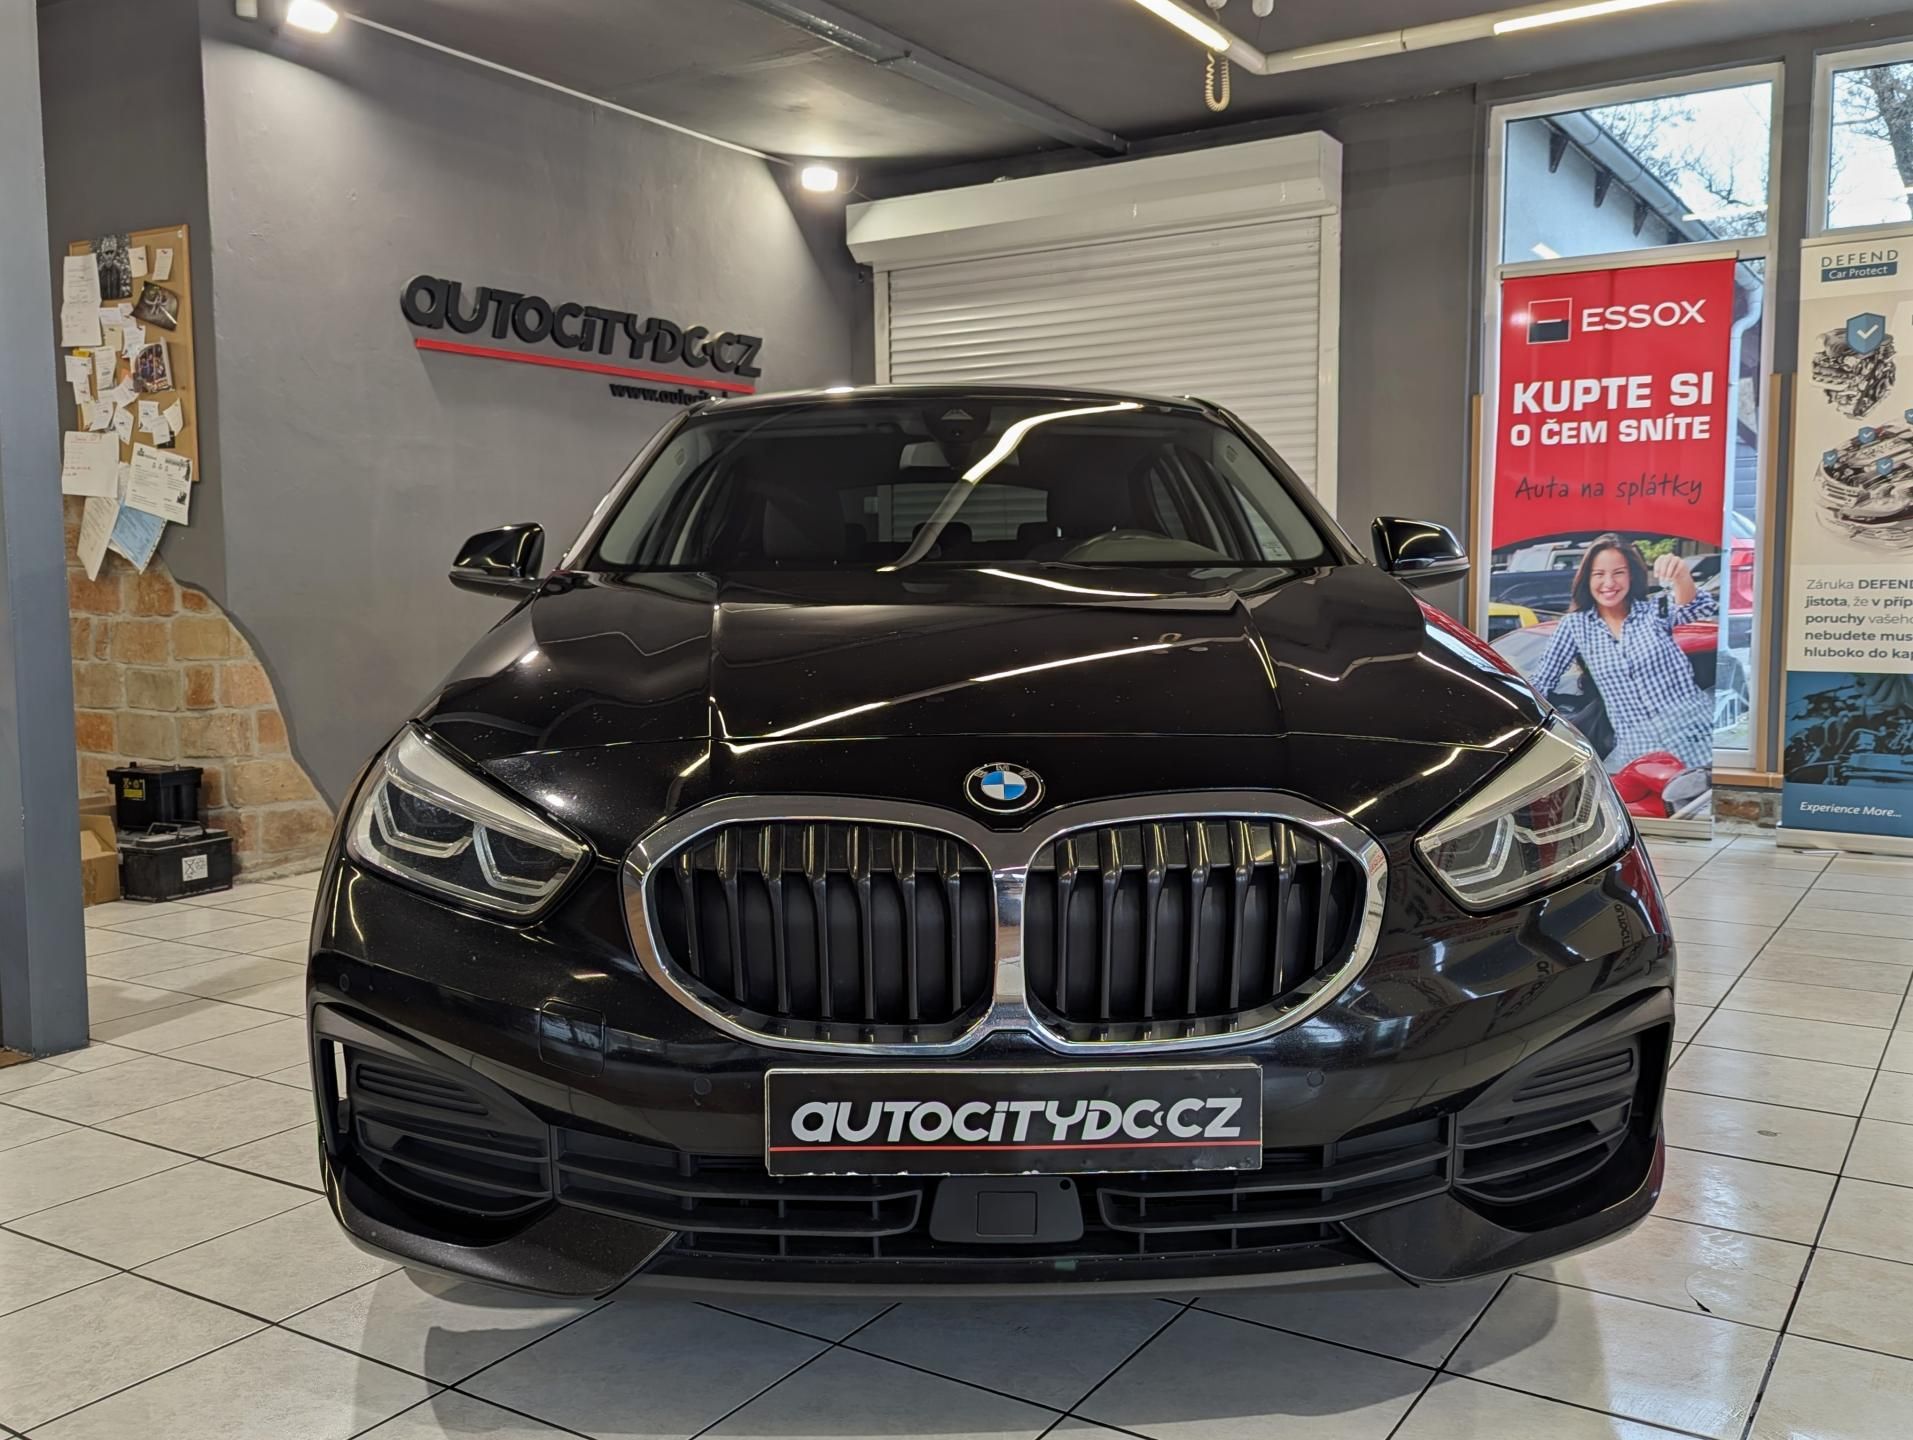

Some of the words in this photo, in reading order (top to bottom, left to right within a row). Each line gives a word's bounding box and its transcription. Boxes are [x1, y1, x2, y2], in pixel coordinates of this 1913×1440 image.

[1820, 249, 1899, 268] DEFEND
[1828, 270, 1847, 280] Car
[1849, 265, 1889, 278] Protect
[1581, 299, 1706, 333] ESSOX
[1512, 374, 1653, 415] KUPTE
[1669, 371, 1714, 407] SI
[1510, 424, 1531, 447] O
[1540, 418, 1608, 446] ČEM
[1618, 413, 1711, 443] SNÍTE
[1515, 476, 1570, 500] Auta
[1581, 481, 1605, 498] na
[1616, 472, 1704, 505] splátky
[1806, 579, 1855, 590] Záruka
[1804, 596, 1851, 609] jistota,
[1853, 597, 1870, 607] že
[1871, 598, 1881, 607] v
[1805, 613, 1866, 626] poruchy
[1804, 630, 1876, 641] nebudete
[1880, 633, 1913, 642] mus
[1804, 647, 1865, 658] hluboko
[1868, 648, 1889, 659] do
[1800, 801, 1861, 815] Experience
